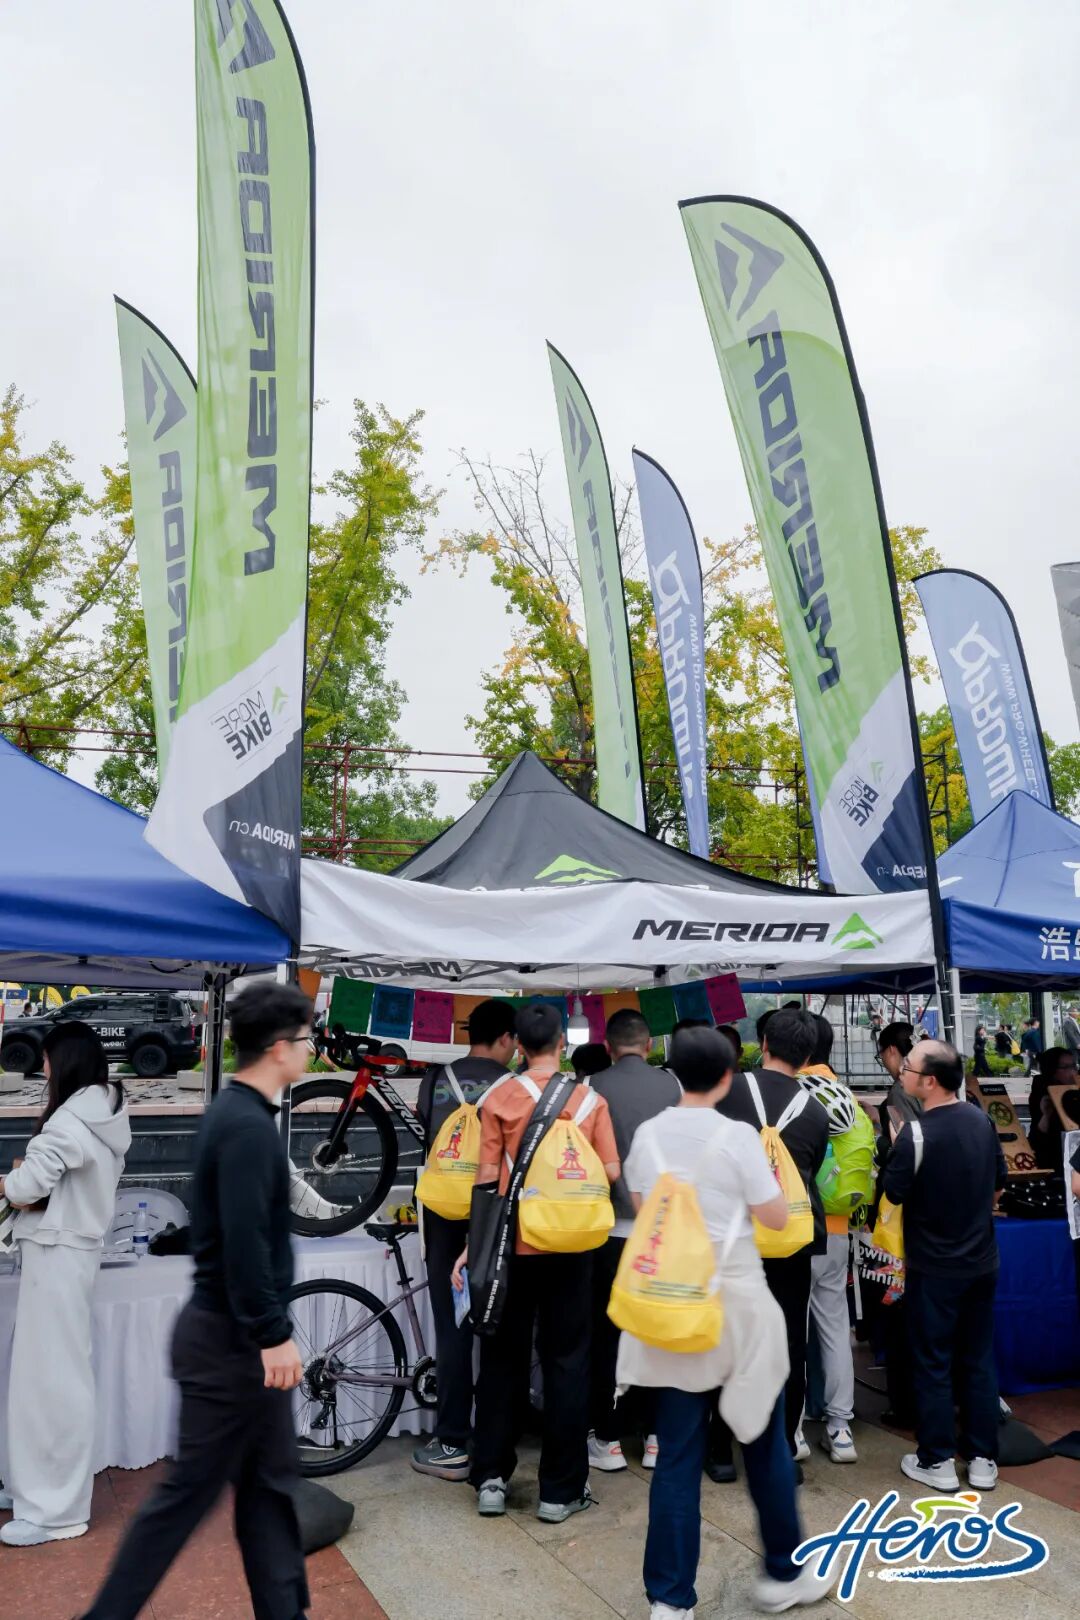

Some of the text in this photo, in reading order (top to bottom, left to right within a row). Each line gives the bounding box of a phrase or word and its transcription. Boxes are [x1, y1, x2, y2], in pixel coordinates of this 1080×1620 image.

[632, 919, 830, 943] MERIDA
[1038, 927, 1080, 962] 浩
[371, 1075, 425, 1140] MERID
